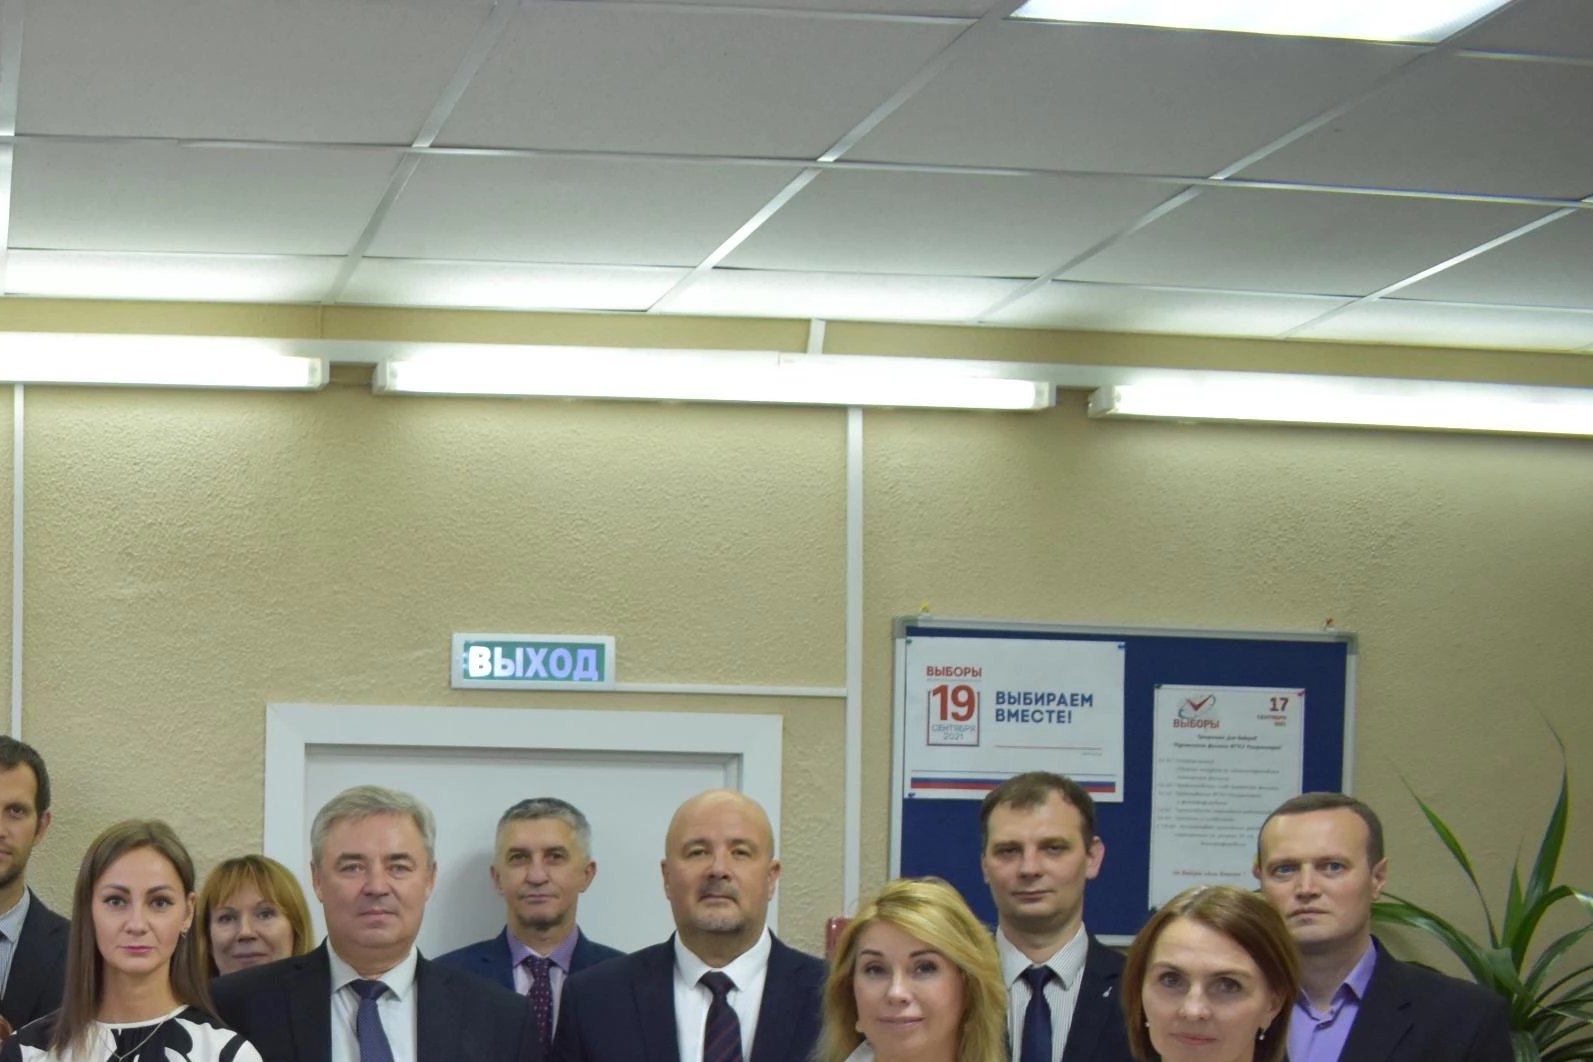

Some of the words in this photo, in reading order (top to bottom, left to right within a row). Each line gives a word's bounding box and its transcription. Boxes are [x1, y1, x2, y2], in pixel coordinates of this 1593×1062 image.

[468, 645, 599, 682] ВЫХОД
[926, 665, 983, 678] ВЫБОРЫ
[932, 684, 976, 722] 19
[995, 690, 1094, 708] ВЫБИРАЕМ
[1269, 697, 1290, 712] 17
[995, 708, 1072, 724] ВМЕСТЕ!
[1173, 718, 1220, 729] ВЫБОРЫ
